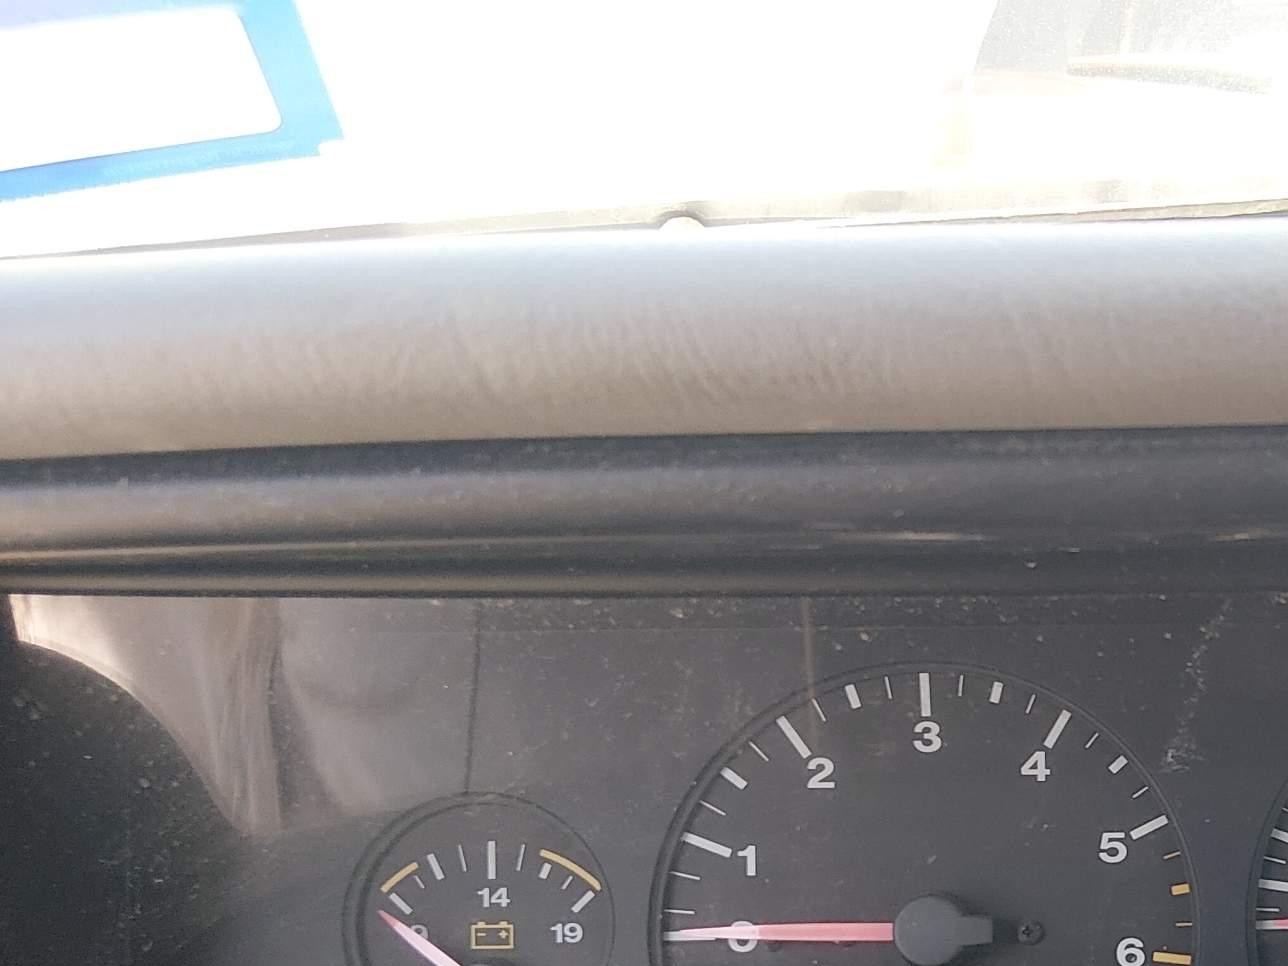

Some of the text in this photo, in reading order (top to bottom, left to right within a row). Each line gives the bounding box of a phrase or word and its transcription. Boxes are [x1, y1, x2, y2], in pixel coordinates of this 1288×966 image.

[913, 721, 942, 753] 3
[806, 757, 836, 789] 2
[1020, 753, 1050, 781] 4
[736, 845, 757, 876] 1
[1098, 832, 1128, 863] 5
[477, 888, 511, 907] 14
[551, 923, 584, 944] 19
[728, 921, 758, 953] 0
